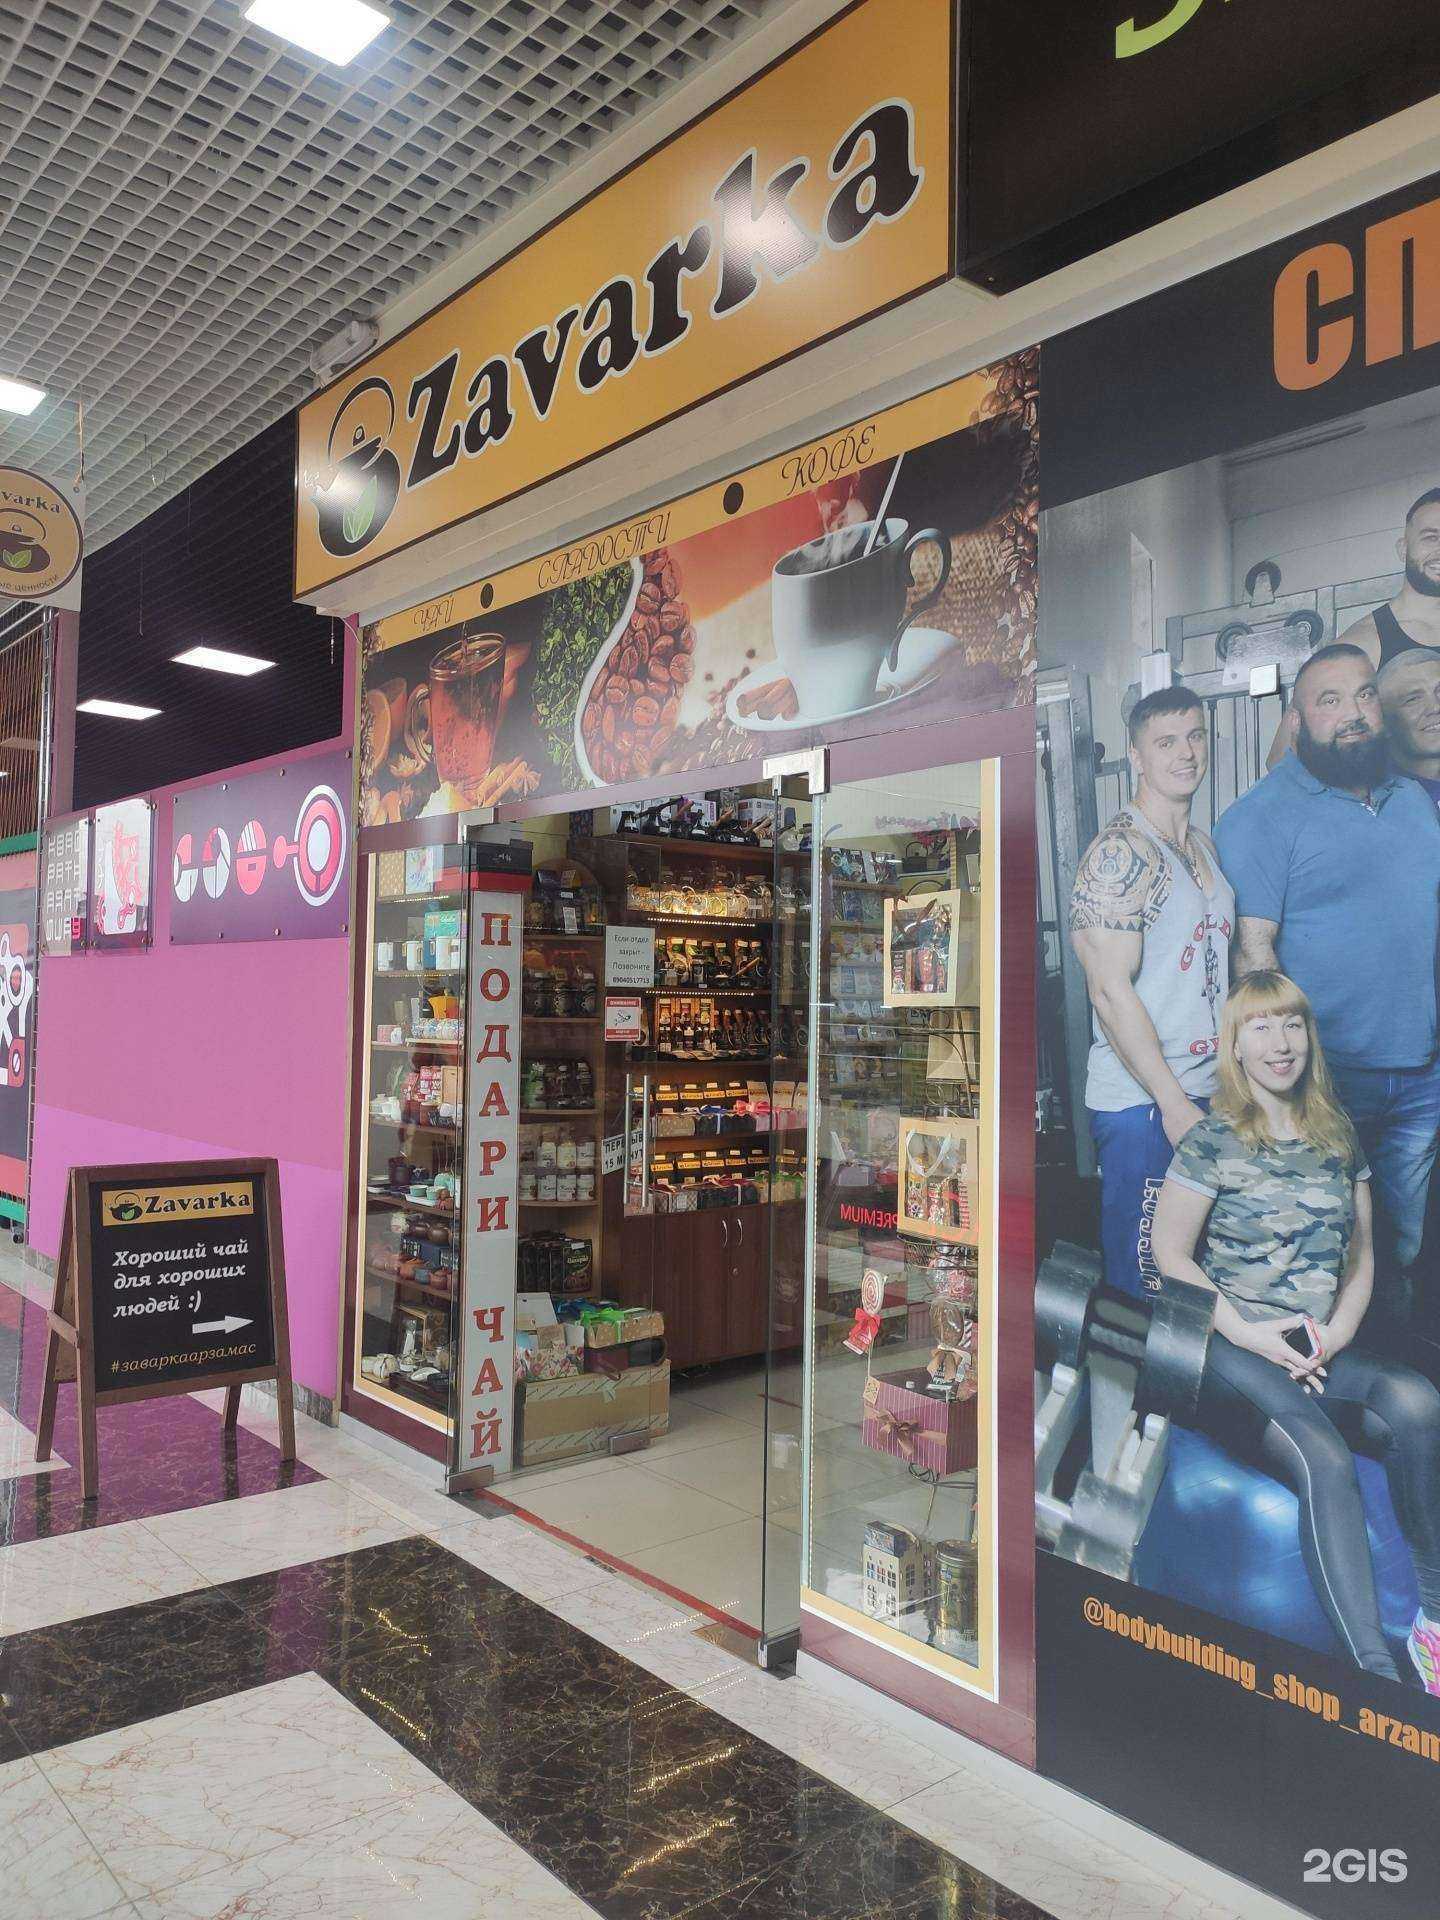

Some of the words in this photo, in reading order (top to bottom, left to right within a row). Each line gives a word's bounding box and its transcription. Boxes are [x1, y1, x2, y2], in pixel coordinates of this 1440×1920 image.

[405, 98, 925, 490] Zavarka
[781, 424, 879, 497] КОФЕ
[537, 511, 671, 590] СЛАДОСТИ
[413, 594, 456, 631] ЧАЙ
[613, 934, 629, 943] Если
[612, 961, 650, 971] Позвоните
[475, 912, 512, 1232] ПОДАРИ
[605, 1133, 643, 1154] ПЕРЕЫВ
[605, 1158, 614, 1170] 15
[144, 1191, 251, 1215] Zavarka
[112, 1242, 207, 1268] Хороший
[212, 1238, 249, 1256] чай
[113, 1272, 152, 1290] для
[157, 1263, 246, 1287] хороших
[112, 1294, 180, 1319] людей
[111, 1342, 257, 1374] #заваркаарзамас
[469, 1306, 505, 1459] ЧАЙ
